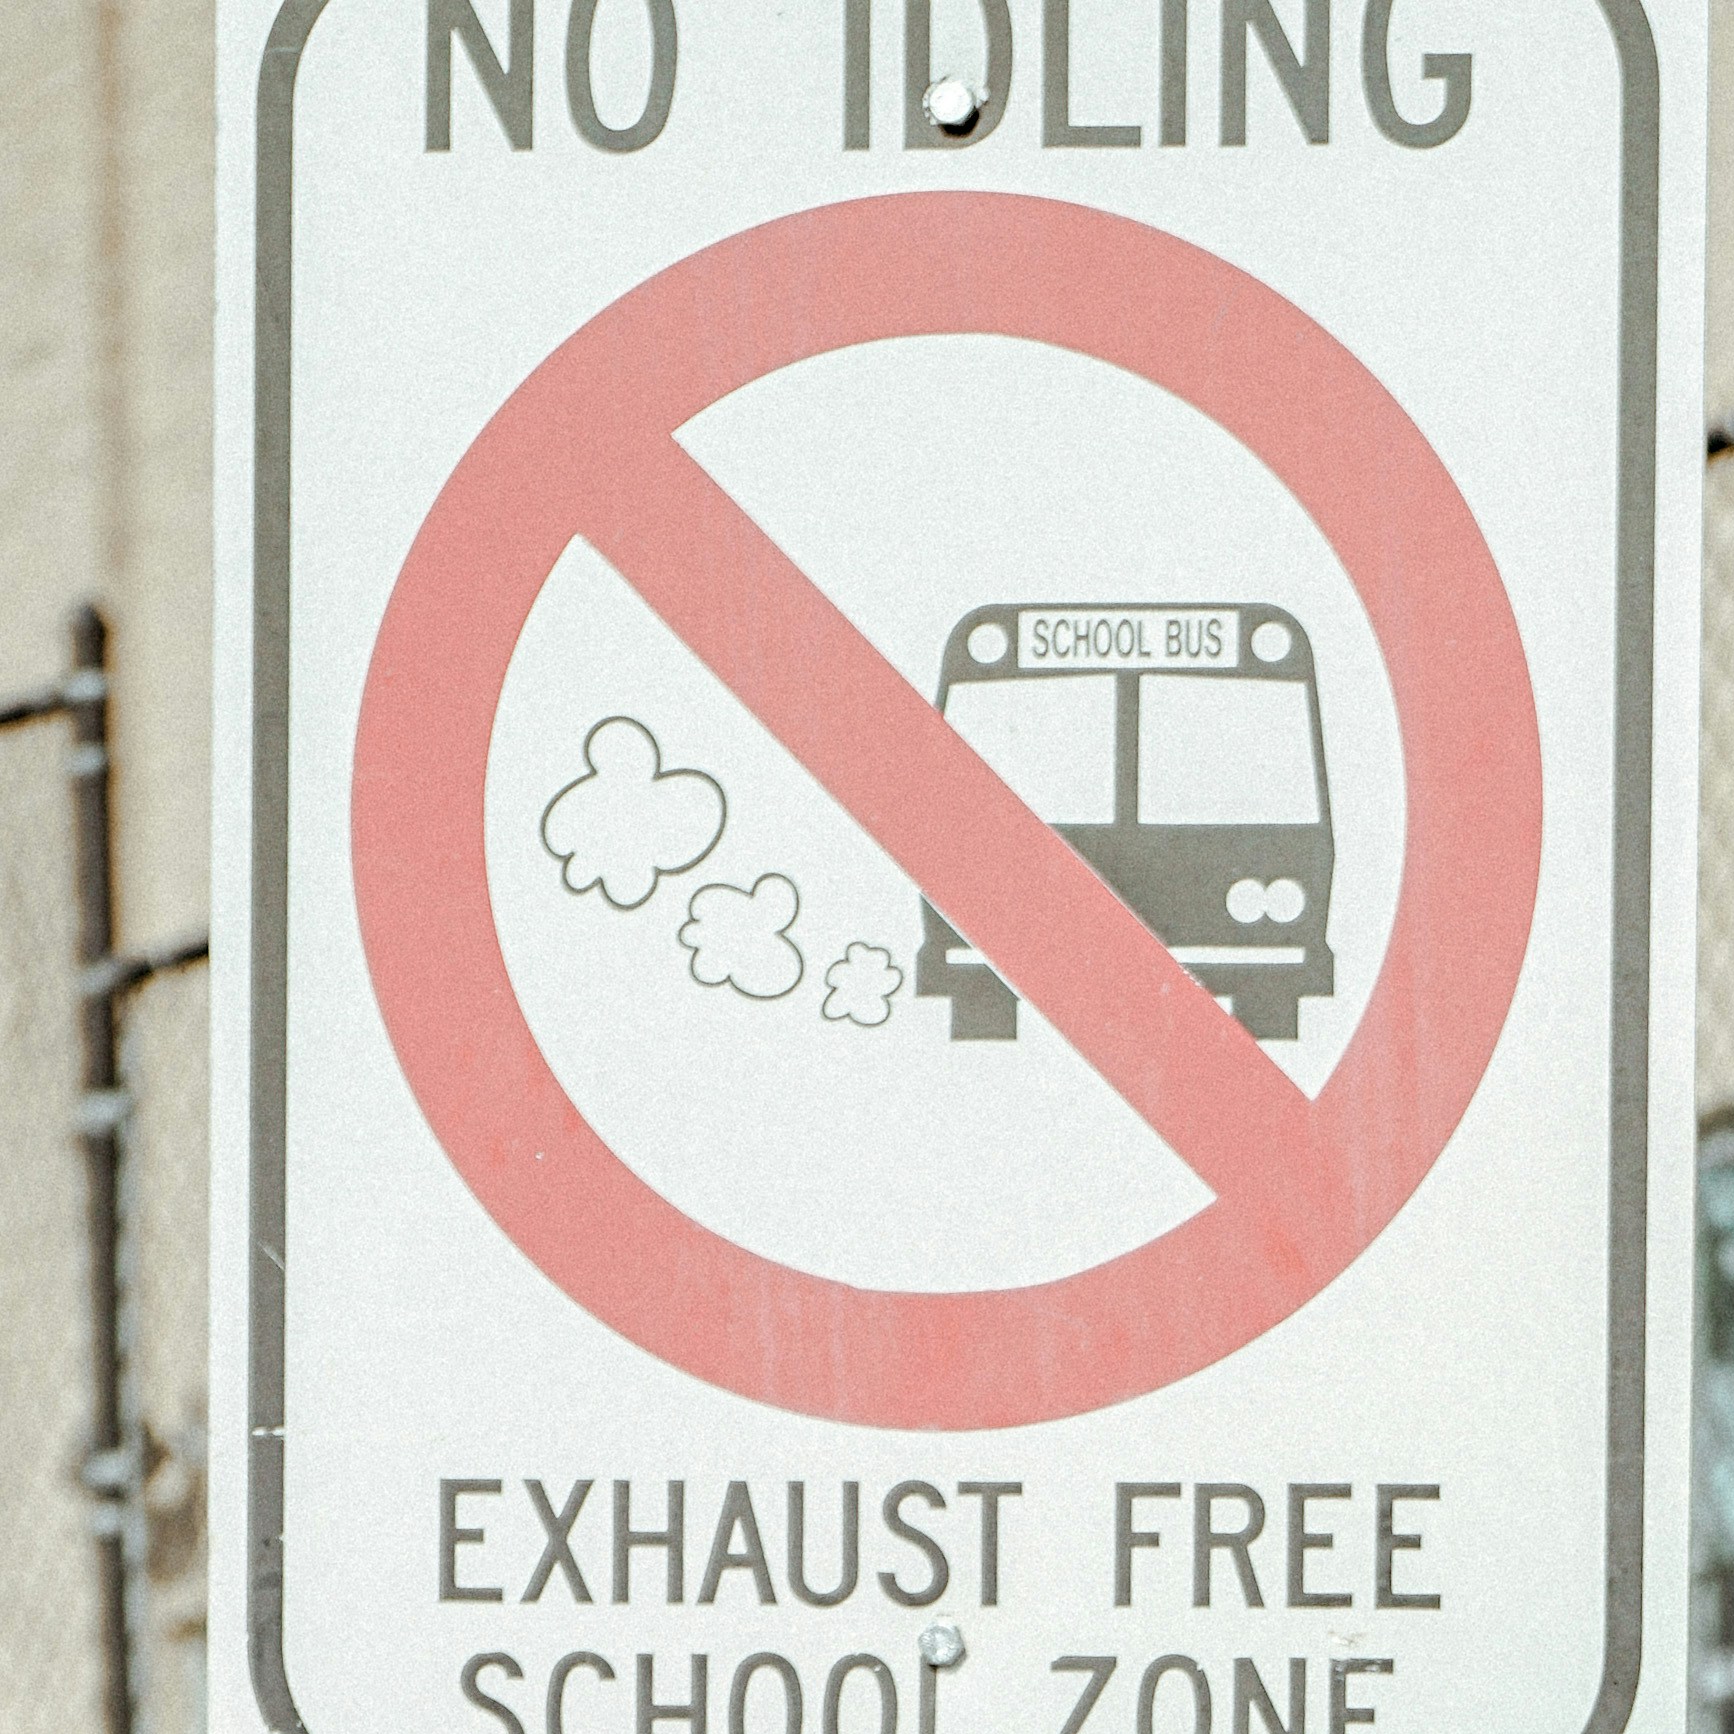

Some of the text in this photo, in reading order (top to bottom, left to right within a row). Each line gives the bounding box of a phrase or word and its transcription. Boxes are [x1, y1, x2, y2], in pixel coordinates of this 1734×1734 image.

[422, 0, 1475, 155] NO IDLING
[1031, 617, 1224, 659] SCHOOL BUS
[436, 1476, 1444, 1610] EXHAUST FREE
